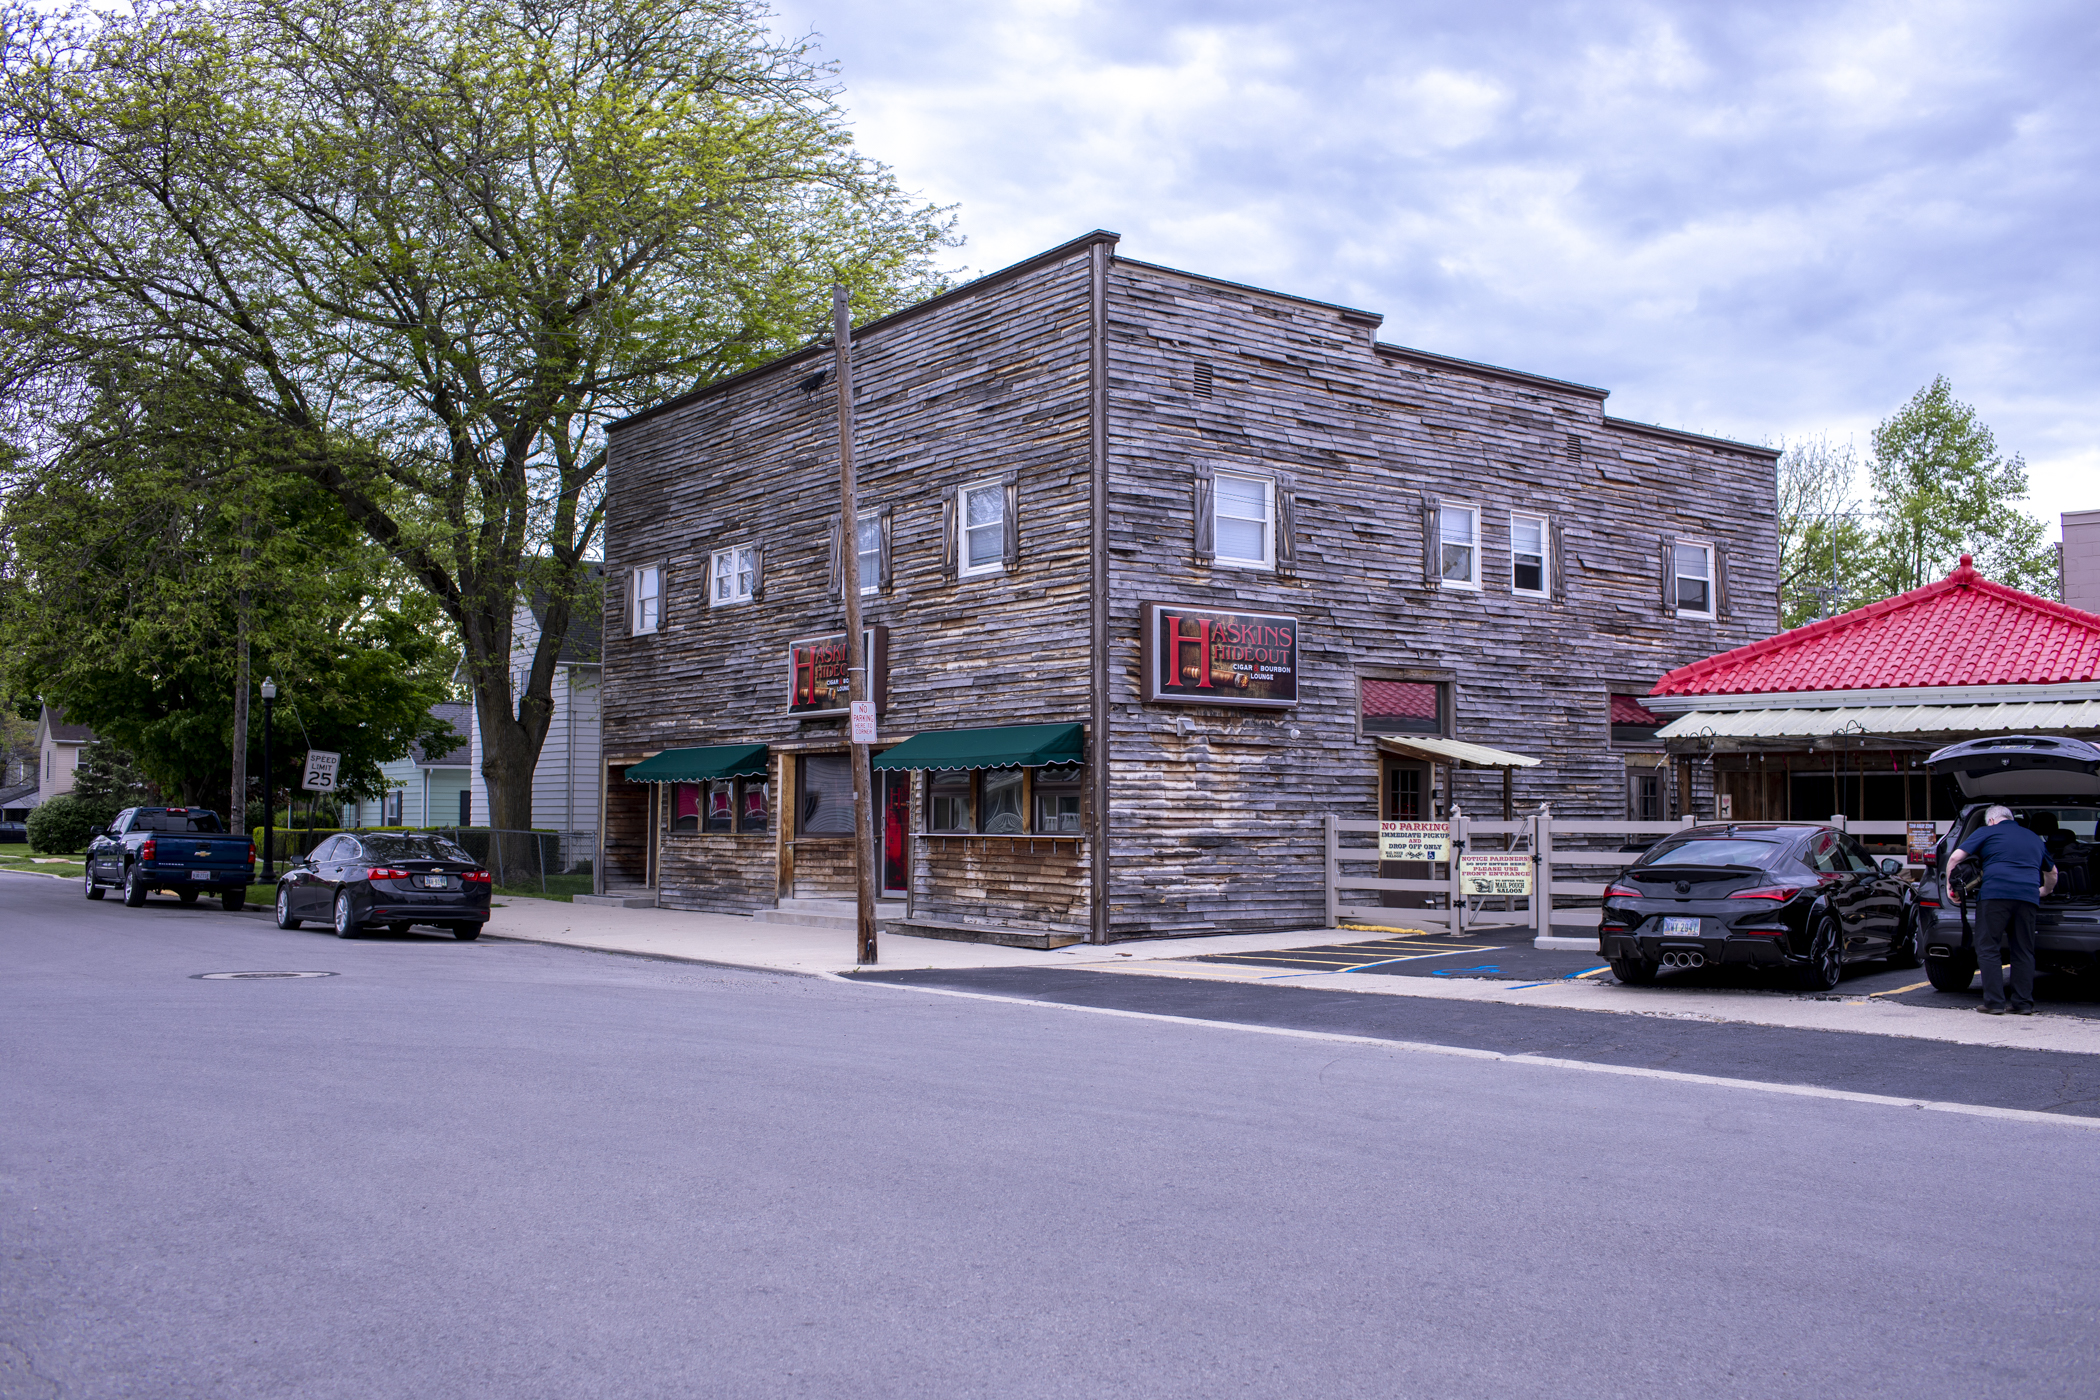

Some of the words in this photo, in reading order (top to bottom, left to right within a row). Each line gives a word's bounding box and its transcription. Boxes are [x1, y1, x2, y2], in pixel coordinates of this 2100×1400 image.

[1165, 615, 1293, 688] HASKINS
[1214, 645, 1290, 664] HIDEOUT
[816, 662, 848, 678] HIDEO
[1232, 663, 1253, 671] CIGAR
[1253, 664, 1260, 672] &
[1260, 666, 1291, 674] BOURBON
[1250, 673, 1274, 681] LOUNGE
[858, 705, 868, 714] NO
[853, 714, 874, 723] PARKING
[310, 755, 337, 763] SPEED
[311, 763, 333, 772] LIMIT
[307, 771, 332, 787] 25
[1381, 822, 1397, 831] NO
[1399, 822, 1450, 832] PARKING
